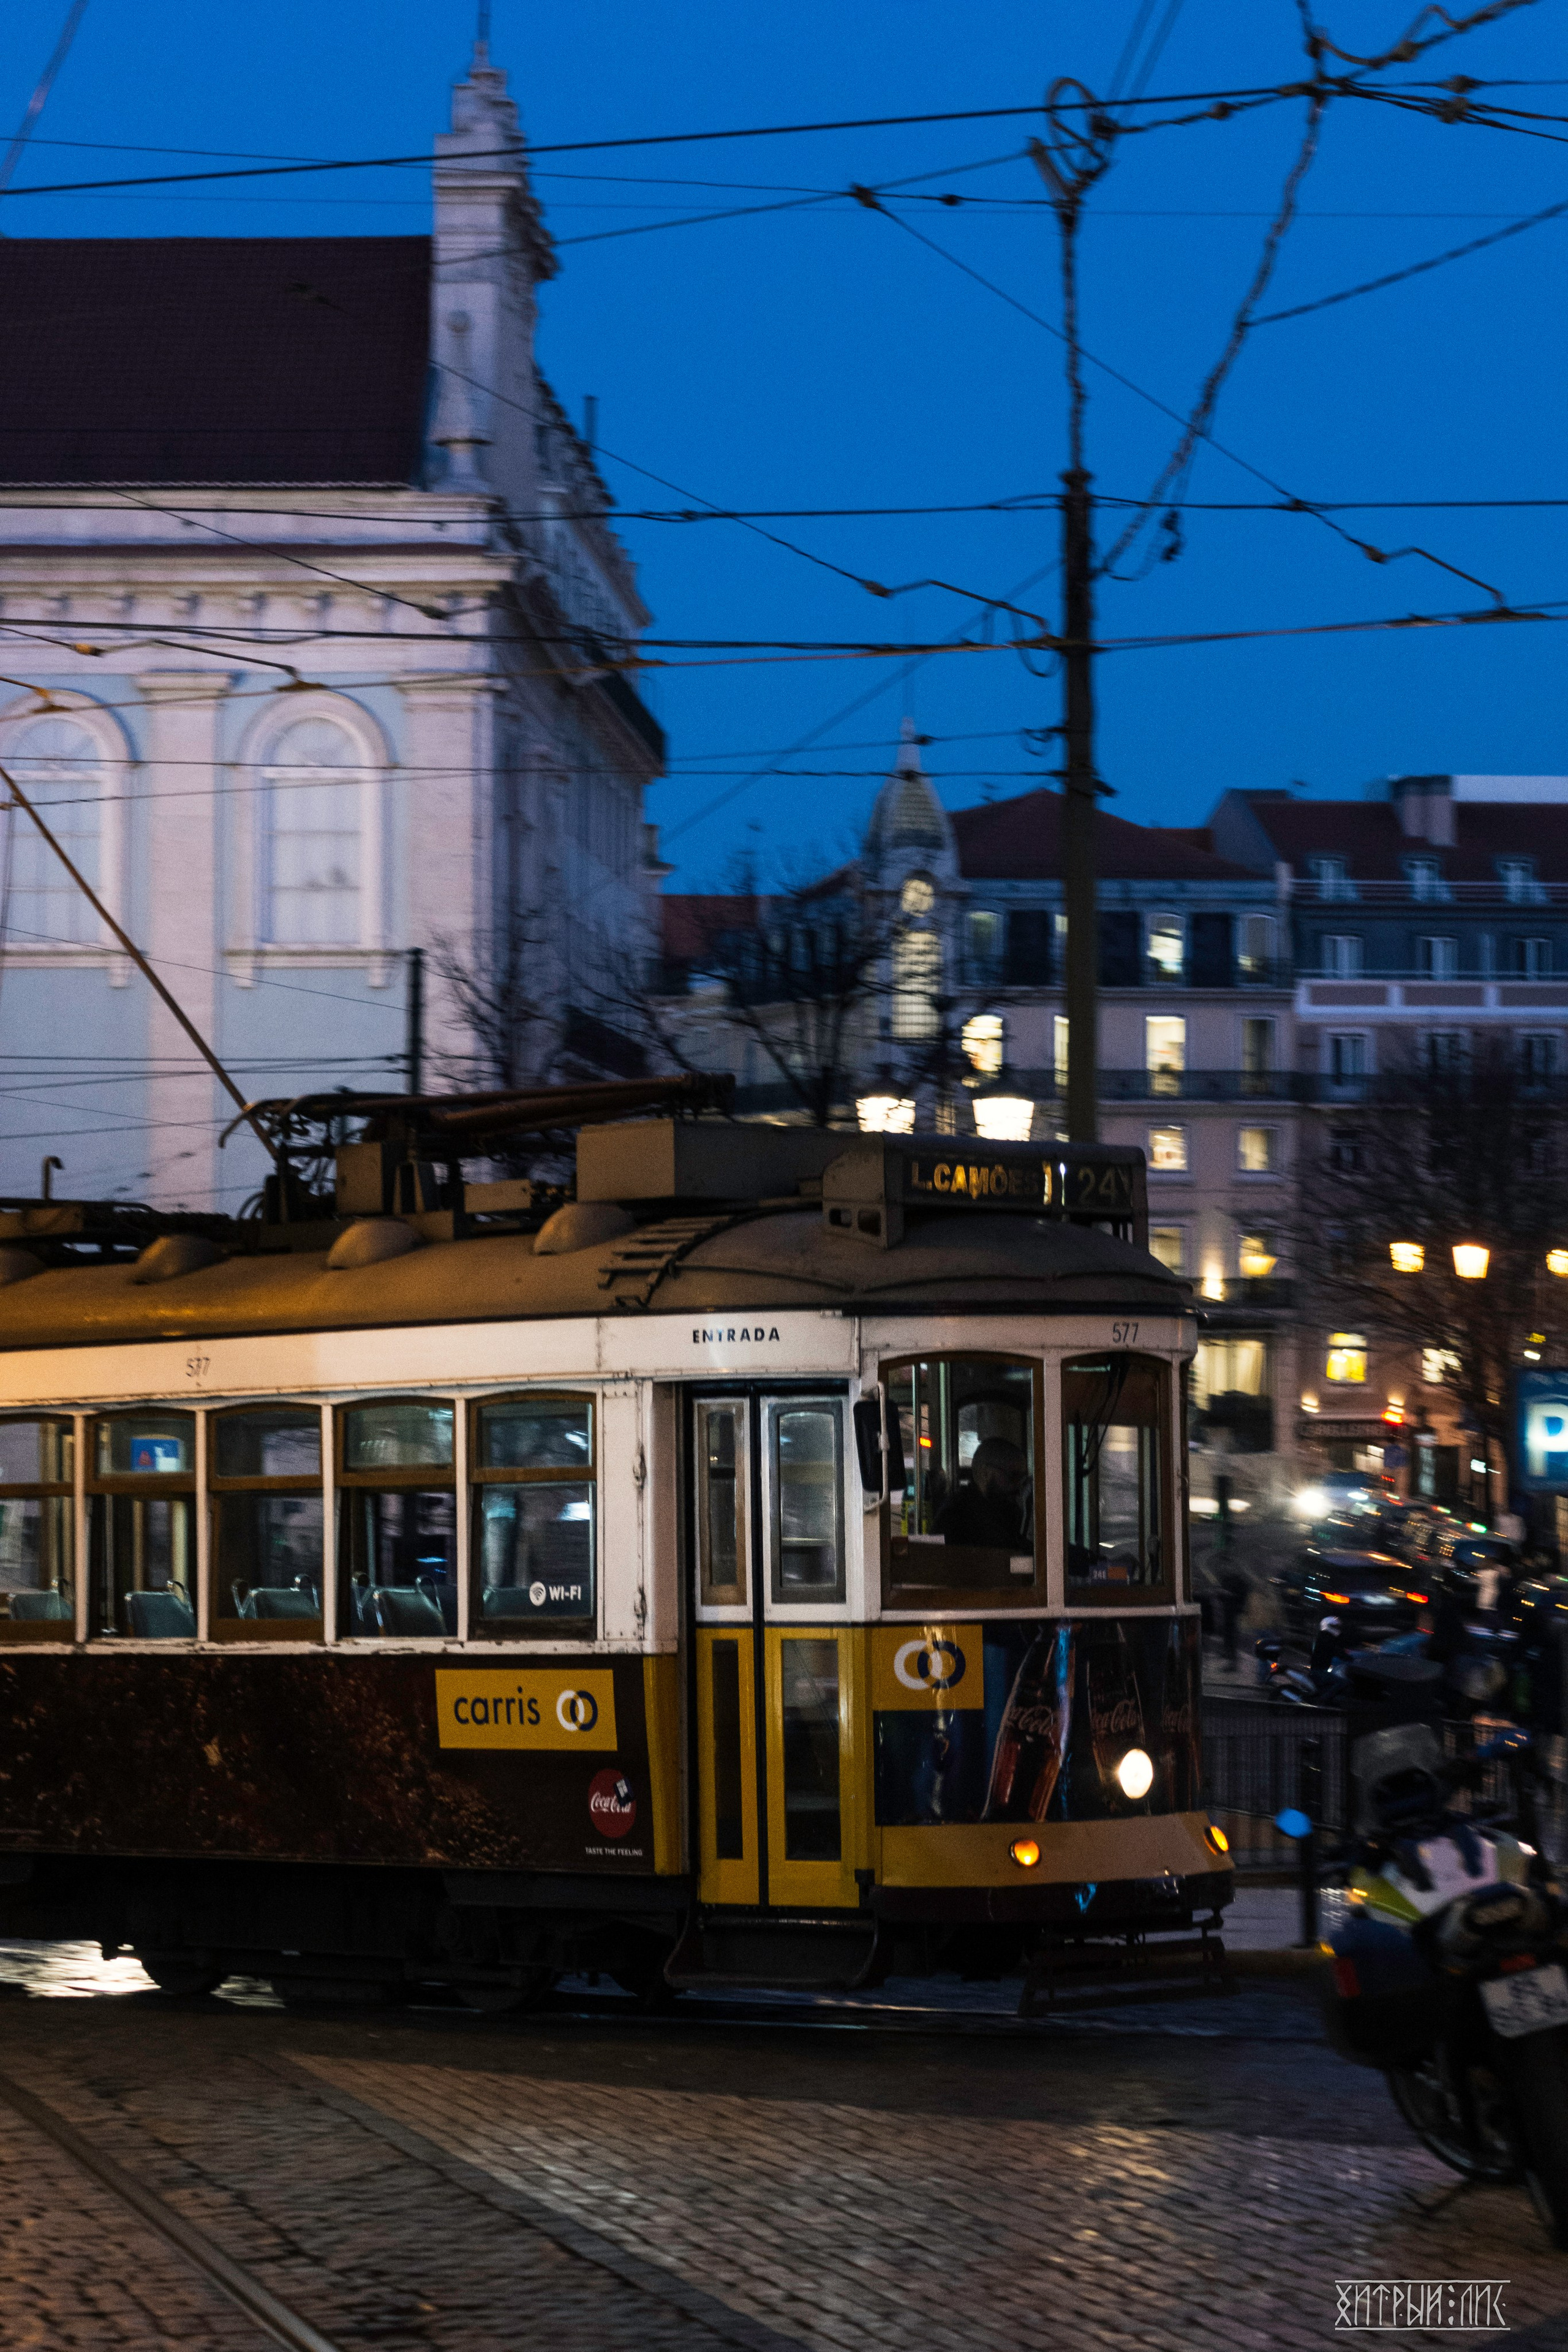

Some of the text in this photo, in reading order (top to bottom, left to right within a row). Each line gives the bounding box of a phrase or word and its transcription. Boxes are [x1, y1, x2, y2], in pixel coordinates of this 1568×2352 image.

[693, 1327, 780, 1343] ENTRADA
[1112, 1322, 1139, 1343] 577
[186, 1356, 211, 1377] 577
[549, 1586, 581, 1601] WI-FI
[454, 1686, 540, 1725] carris
[585, 1846, 643, 1857] TASTE THE FEELING
